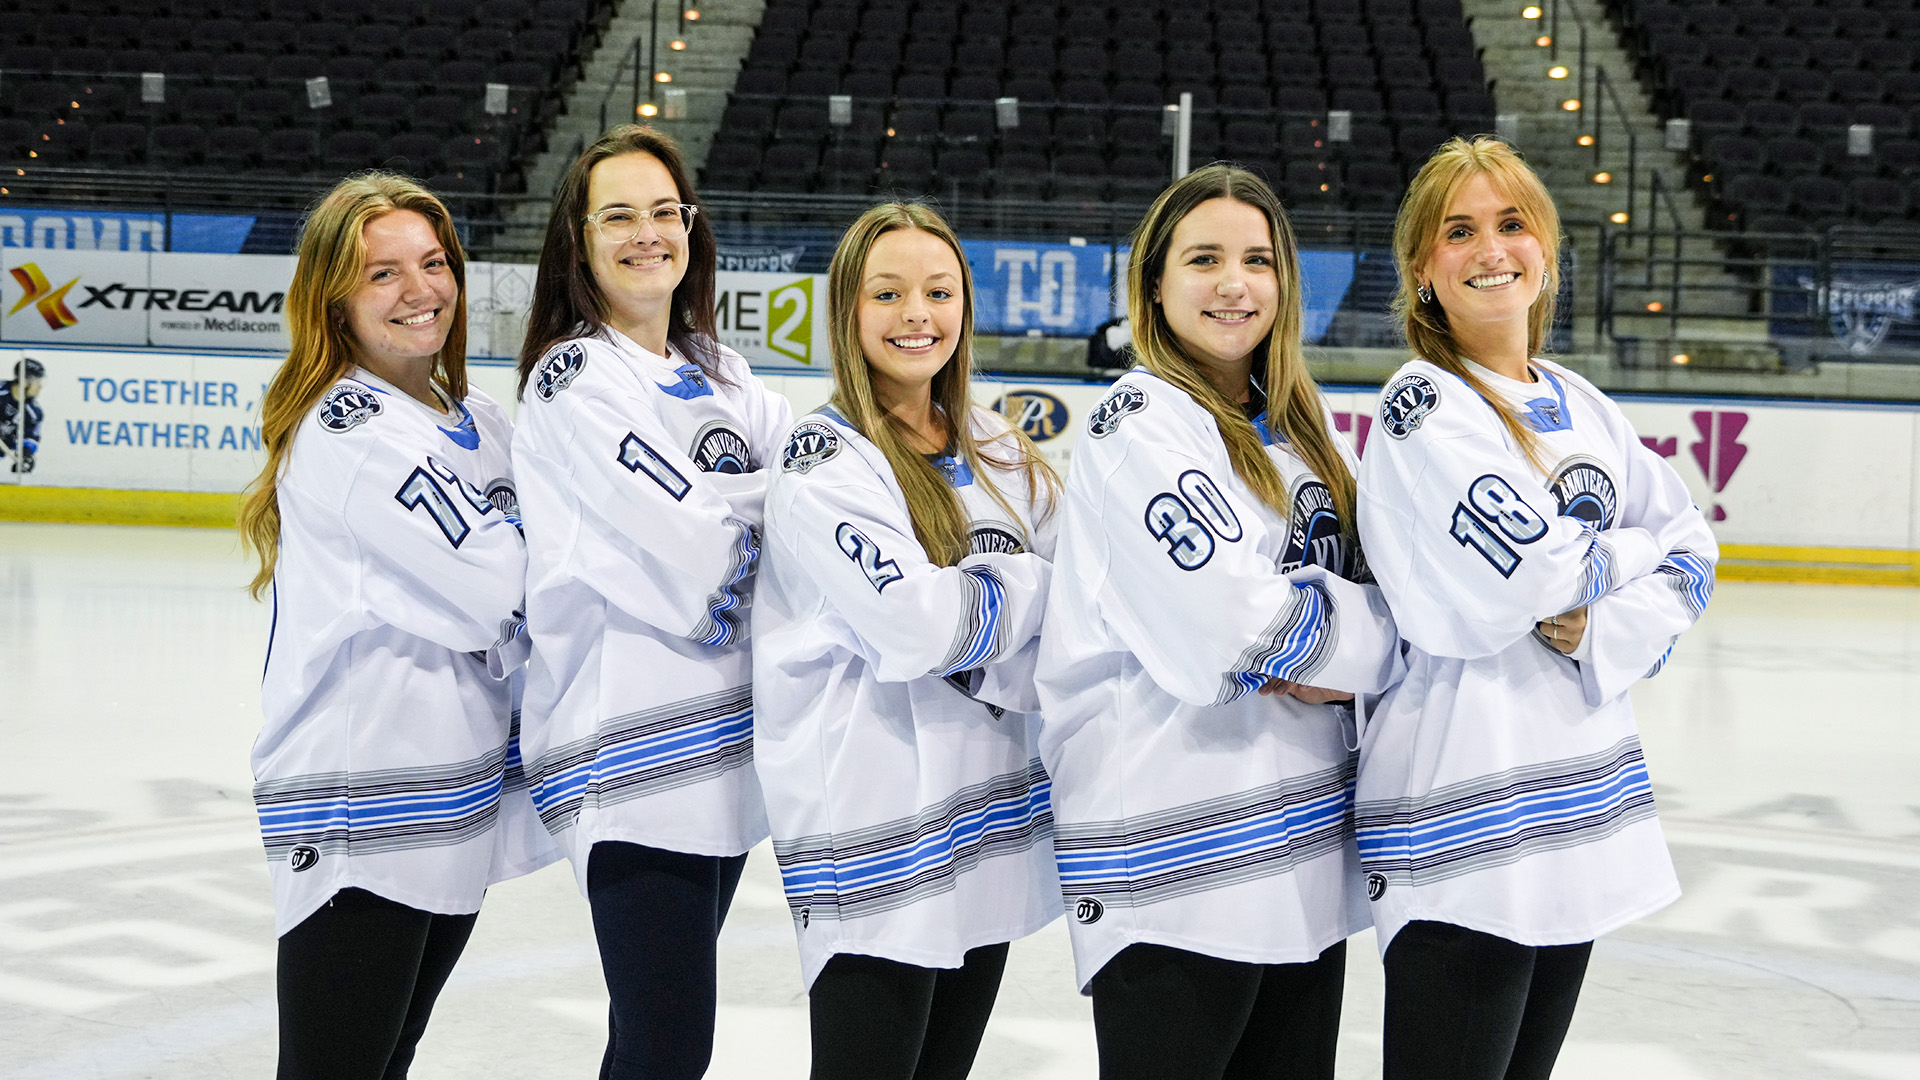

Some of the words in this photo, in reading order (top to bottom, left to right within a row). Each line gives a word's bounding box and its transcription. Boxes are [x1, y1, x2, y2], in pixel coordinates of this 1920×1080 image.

[77, 283, 286, 313] XTREAM
[994, 248, 1077, 327] TO
[204, 317, 280, 333] Mediacom
[772, 286, 808, 358] 2
[545, 352, 567, 384] XV
[78, 377, 238, 407] TOGETHER
[332, 393, 363, 417] XV
[1103, 392, 1127, 421] XV
[1391, 386, 1418, 420] XV
[65, 420, 210, 449] WEATHER
[794, 434, 821, 458] XV
[616, 430, 693, 502] 1
[1144, 469, 1243, 571] 30
[1448, 473, 1549, 580] 18
[835, 522, 904, 595] 2
